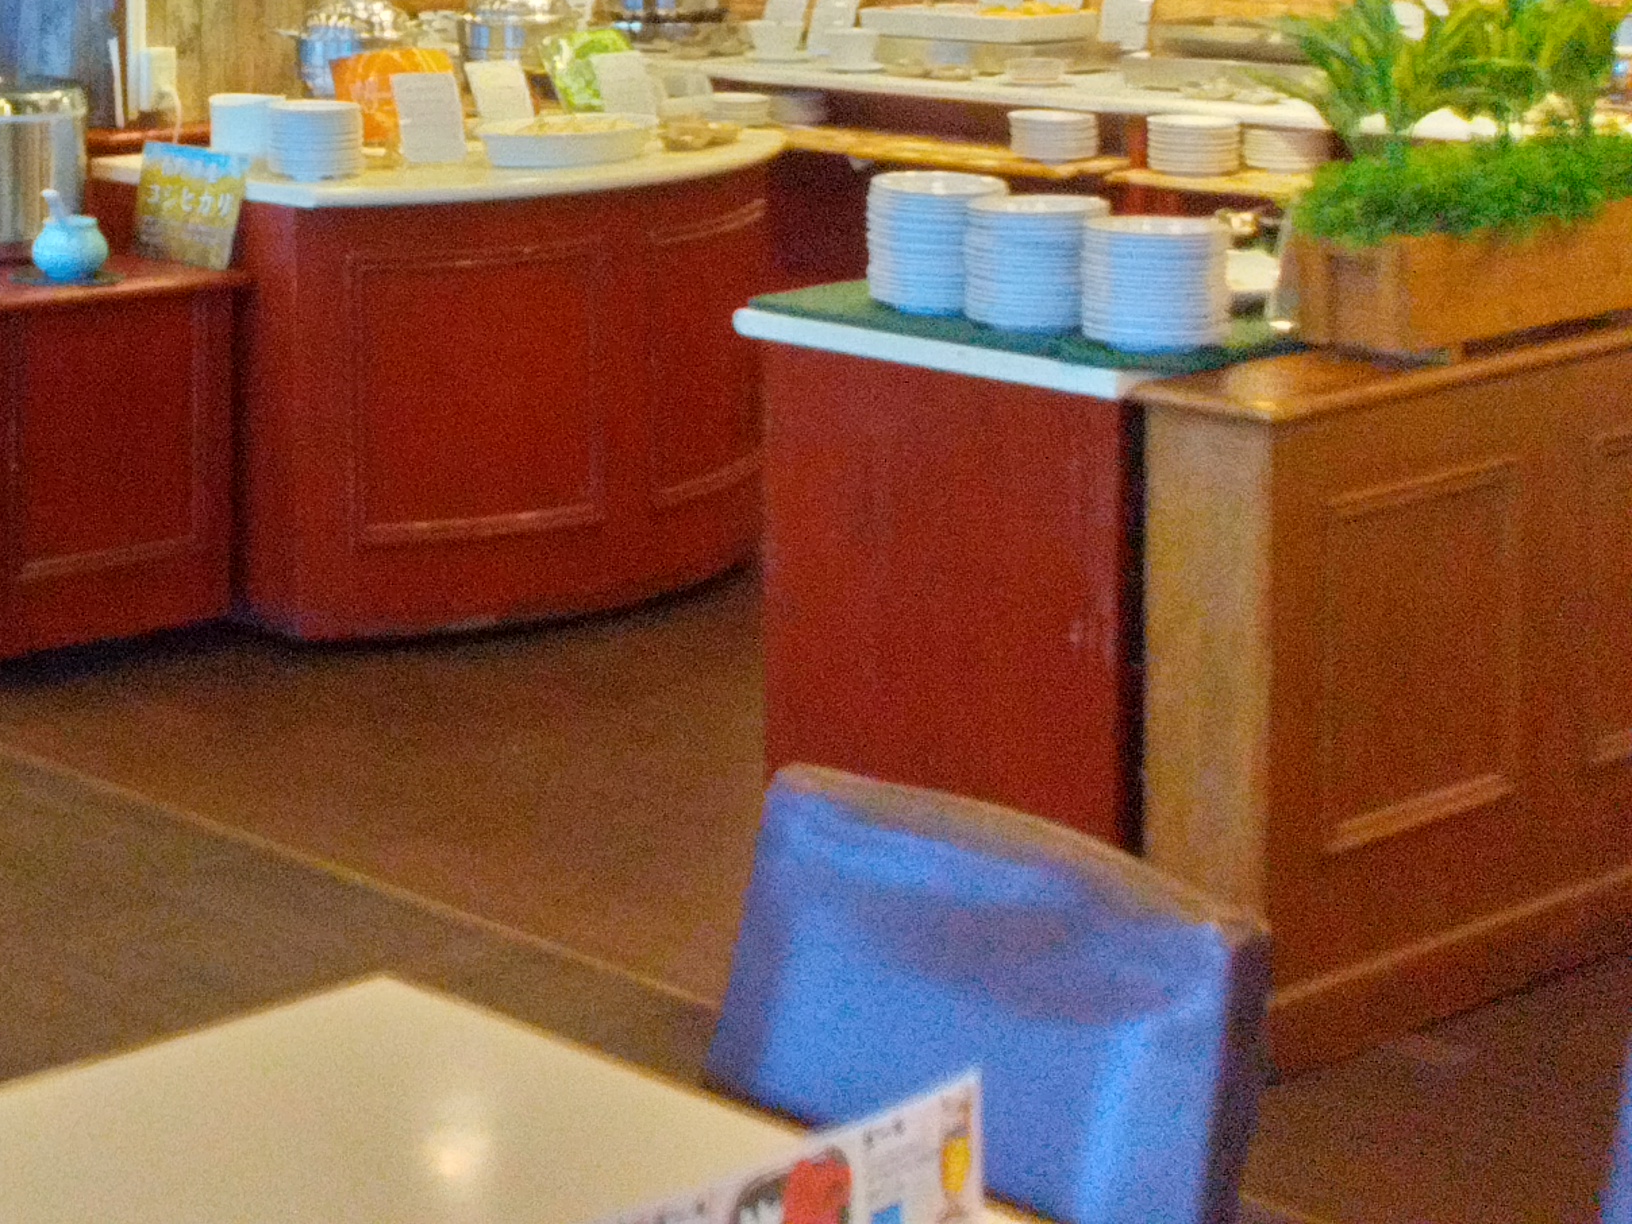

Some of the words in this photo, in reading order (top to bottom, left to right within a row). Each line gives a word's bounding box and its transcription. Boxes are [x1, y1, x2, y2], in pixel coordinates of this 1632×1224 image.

[146, 184, 233, 217] コシヒカリ
